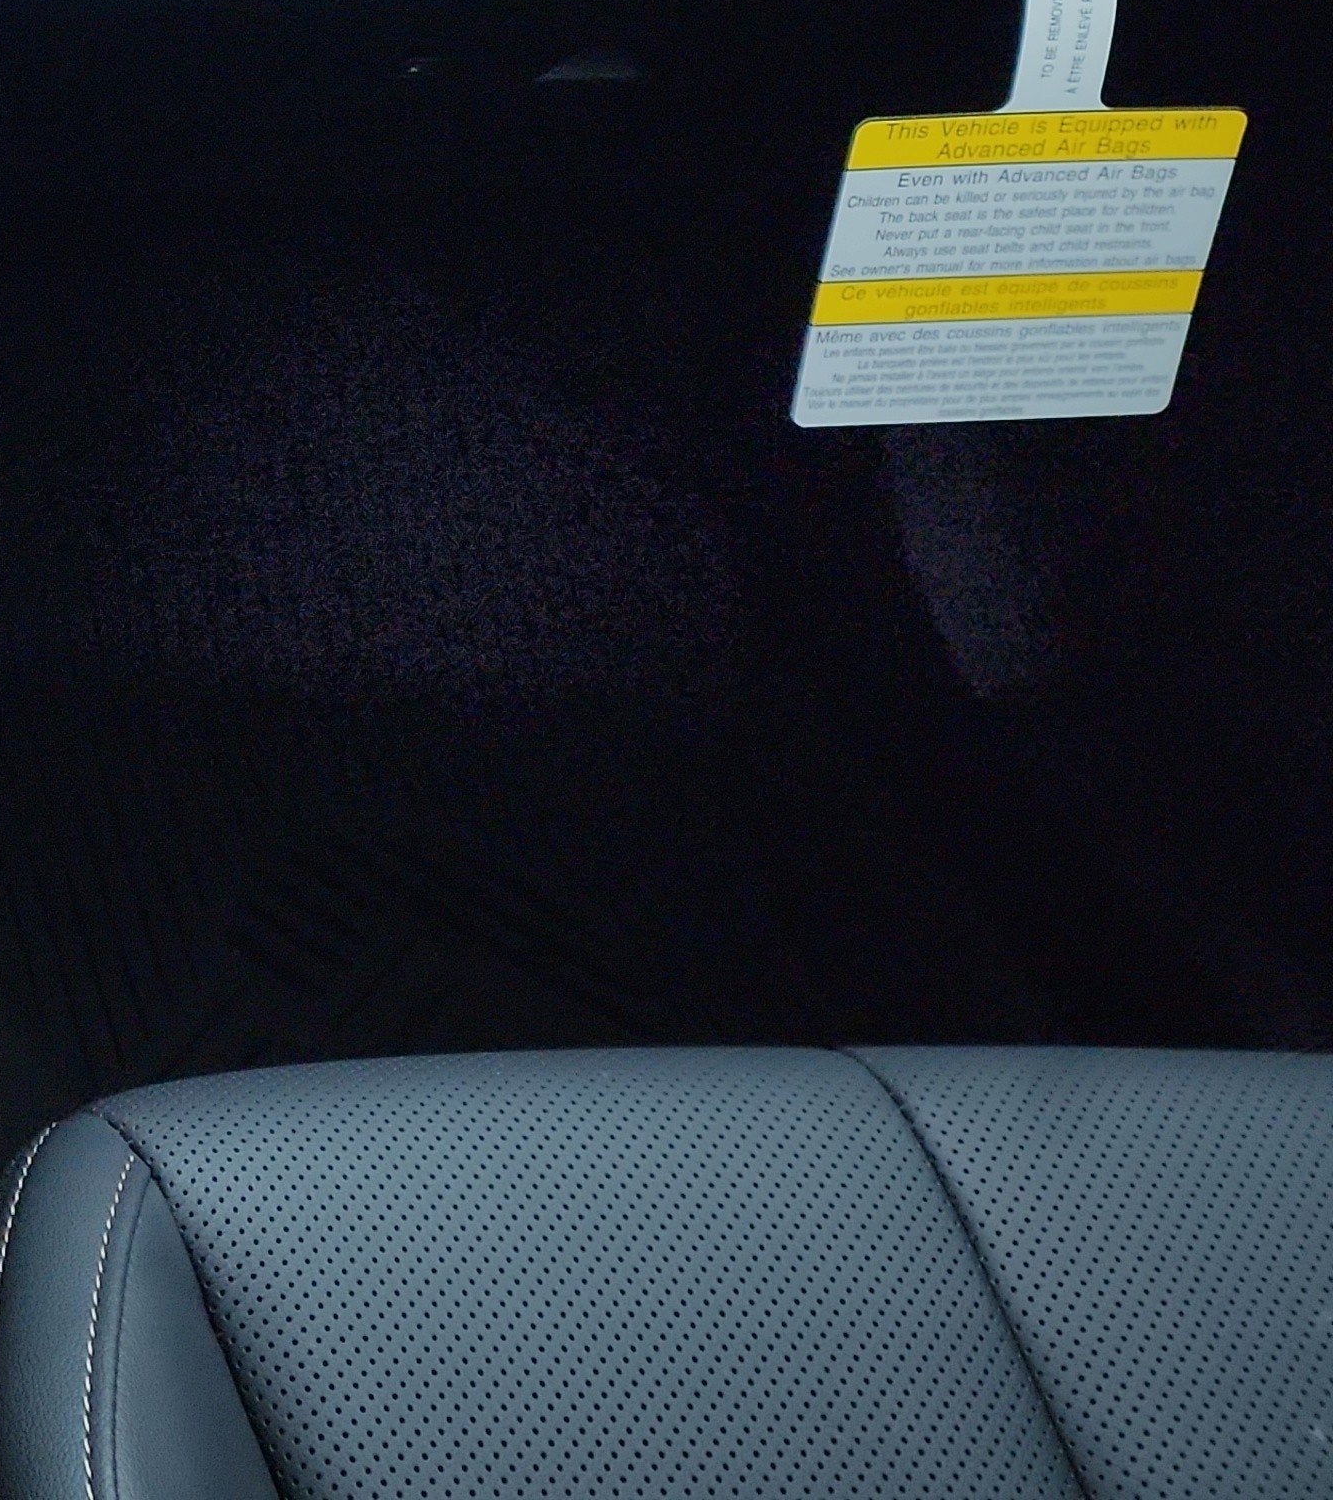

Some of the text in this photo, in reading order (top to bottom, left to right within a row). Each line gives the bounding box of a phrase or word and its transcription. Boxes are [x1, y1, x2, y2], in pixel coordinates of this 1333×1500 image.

[1044, 46, 1058, 61] BE
[1041, 63, 1055, 79] TO
[886, 114, 1218, 141] This Vehicle is Equipped with
[935, 136, 1151, 160] Advanced Air Bags
[897, 164, 1179, 188] Even with Advanced Air Bags
[847, 193, 900, 209] Children
[905, 193, 929, 206] can
[933, 191, 950, 205] be
[955, 189, 990, 204] killed
[993, 191, 1008, 203] or
[879, 211, 904, 225] The
[908, 209, 938, 224] back
[943, 208, 972, 222] seat
[976, 208, 988, 221] is
[993, 206, 1013, 220] the
[875, 228, 913, 241] Never
[917, 227, 939, 243] put
[943, 228, 953, 240] a
[883, 245, 928, 260] Always
[933, 244, 958, 257] use
[830, 263, 857, 278] See
[840, 284, 867, 301] Ce
[869, 330, 907, 344] avec
[912, 327, 940, 342] des
